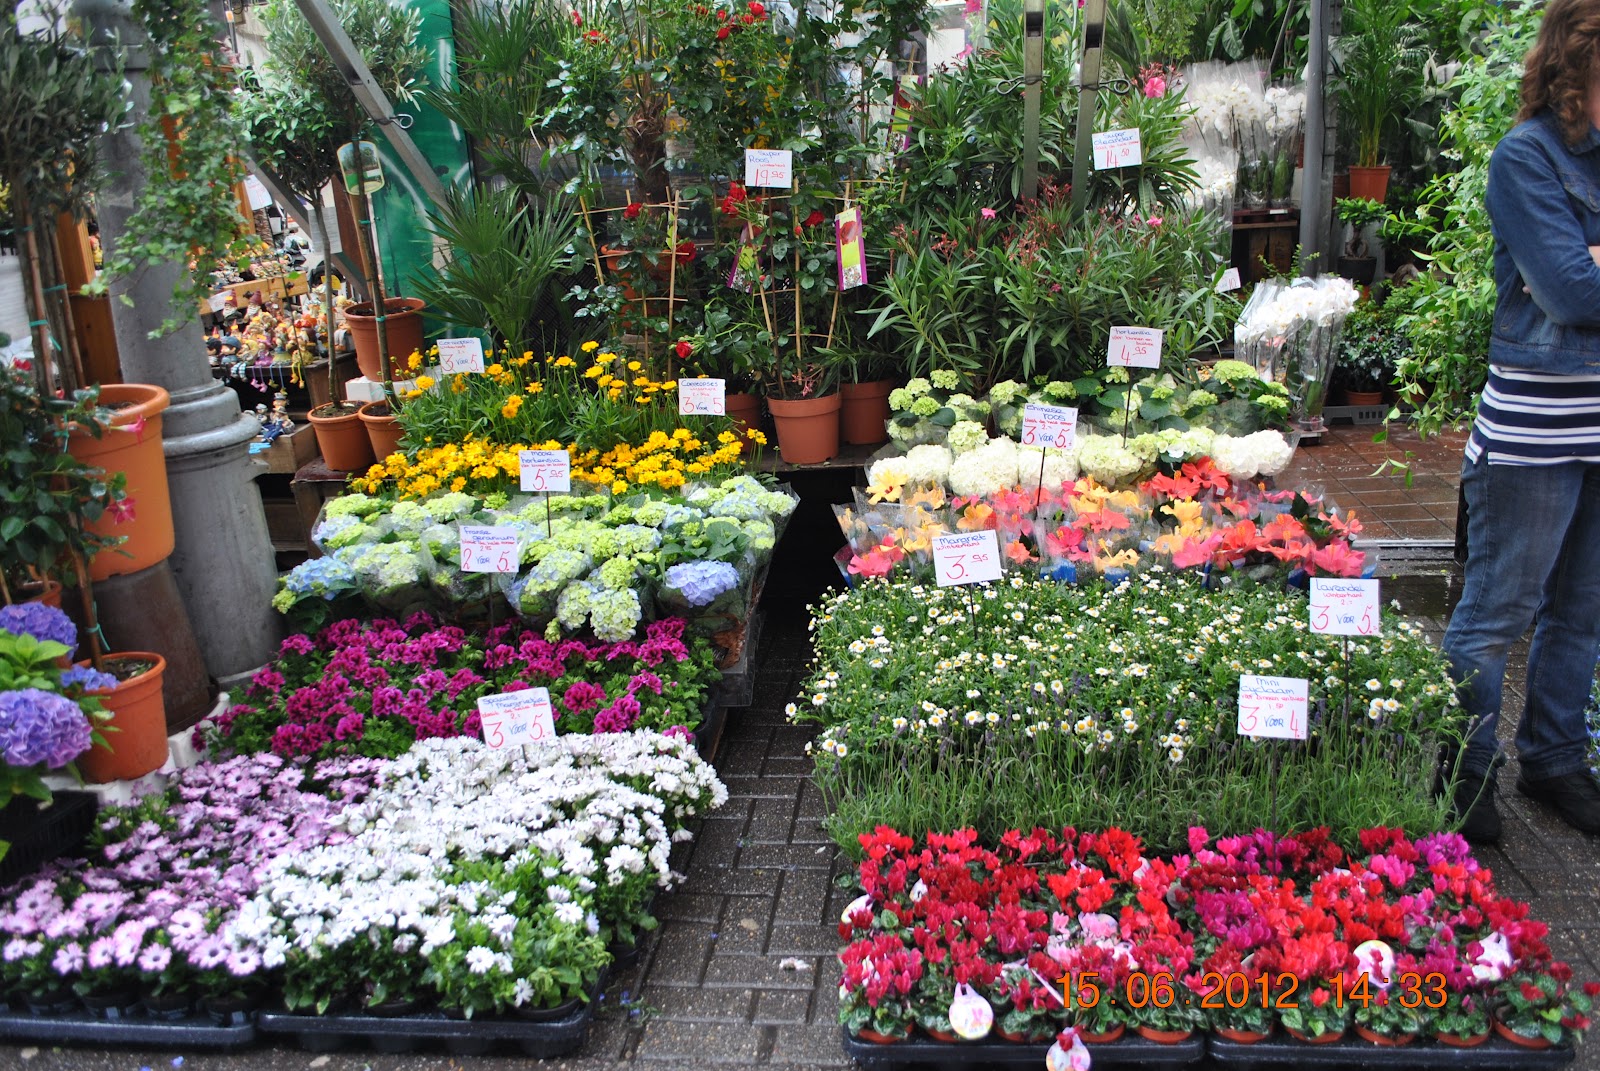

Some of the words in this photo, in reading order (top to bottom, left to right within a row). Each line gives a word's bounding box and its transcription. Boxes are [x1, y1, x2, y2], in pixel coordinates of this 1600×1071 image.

[748, 155, 770, 163] Roos
[440, 353, 454, 372] 3
[682, 396, 695, 414] 3
[1022, 424, 1037, 445] 3
[1311, 603, 1330, 631] 3
[1239, 704, 1260, 732] 3
[484, 721, 504, 748] 3
